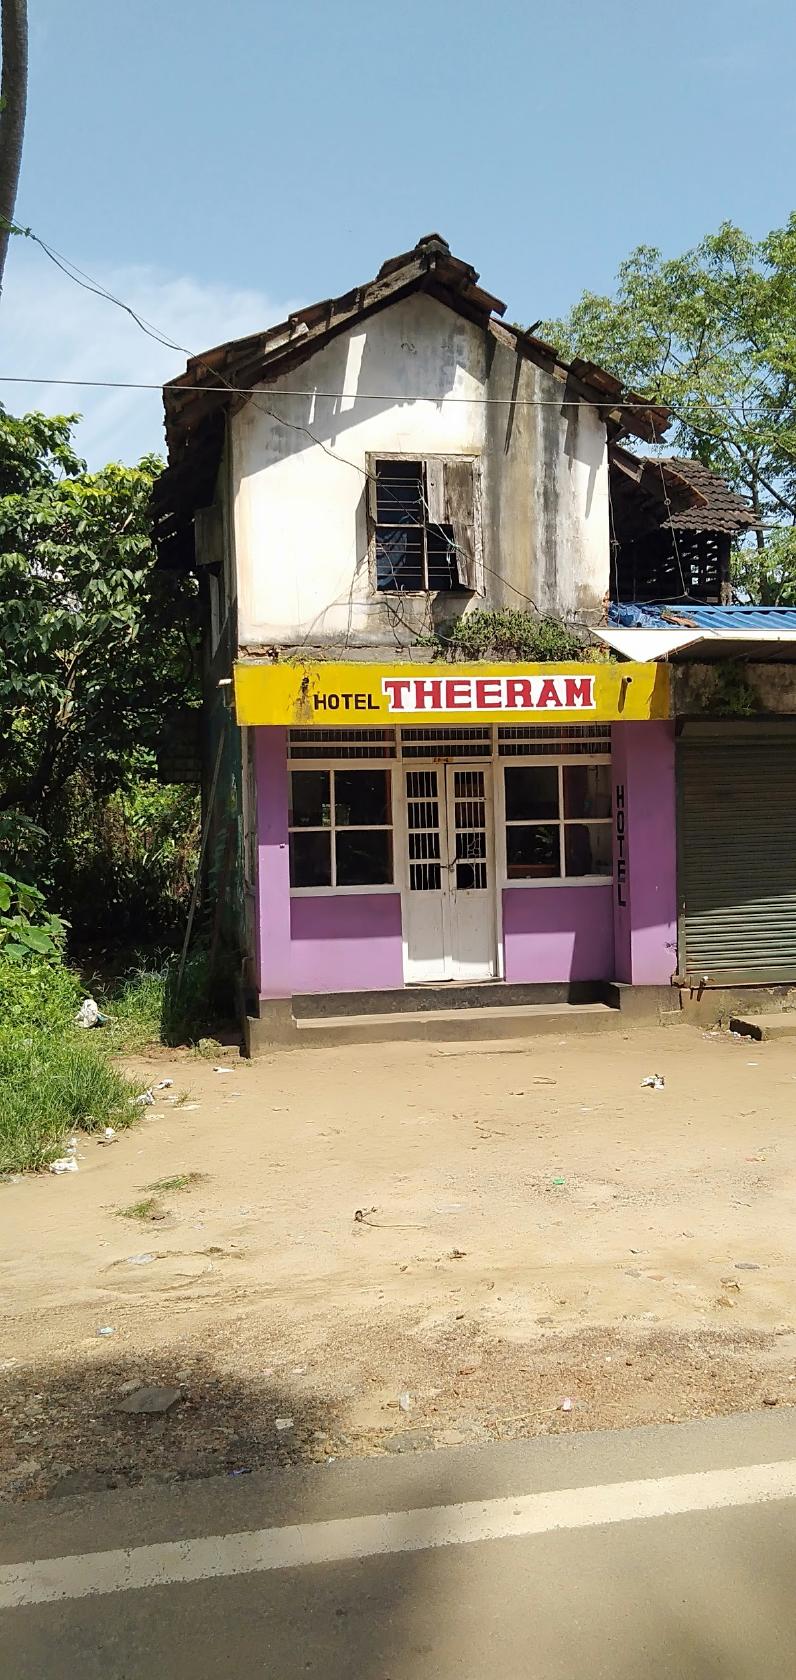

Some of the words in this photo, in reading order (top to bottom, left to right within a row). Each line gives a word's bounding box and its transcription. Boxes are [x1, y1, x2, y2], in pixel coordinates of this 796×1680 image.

[314, 693, 380, 710] HOTEL
[384, 678, 593, 709] THEERAM
[616, 785, 626, 907] HOTEL
